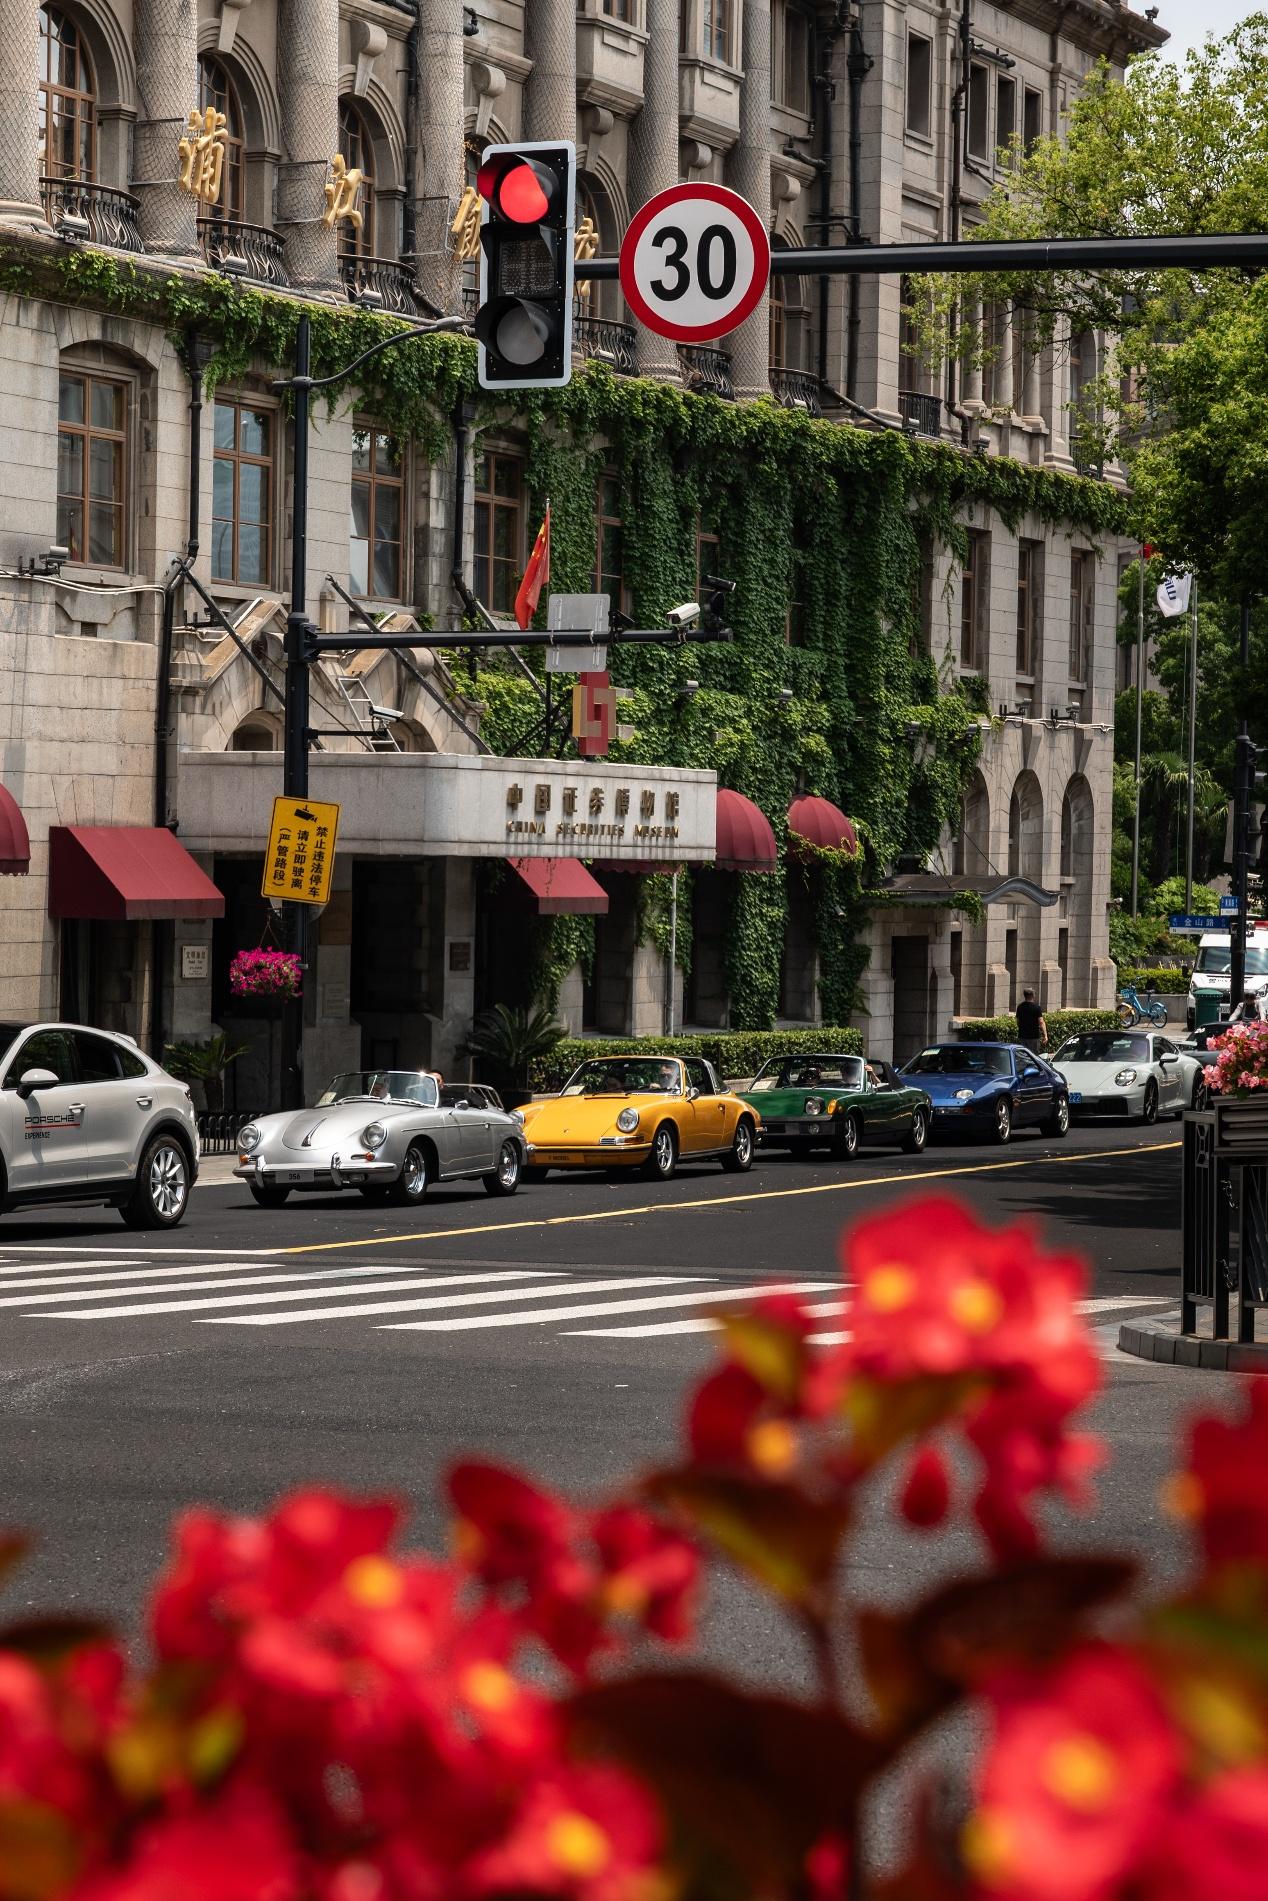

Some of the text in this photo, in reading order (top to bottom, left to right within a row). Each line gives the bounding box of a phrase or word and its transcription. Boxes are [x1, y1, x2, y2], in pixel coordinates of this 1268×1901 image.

[650, 224, 737, 302] 30
[506, 783, 680, 820] 中国证券博物馆
[506, 821, 679, 838] CHINA SECURITIES MUSEUM
[291, 829, 309, 890] 请立即驶离
[308, 826, 328, 898] 禁止违法停车
[1184, 917, 1214, 927] 金山路
[25, 1114, 75, 1124] PORSCHE
[25, 1131, 51, 1140] EXPERIENCE
[288, 1173, 301, 1181] 356
